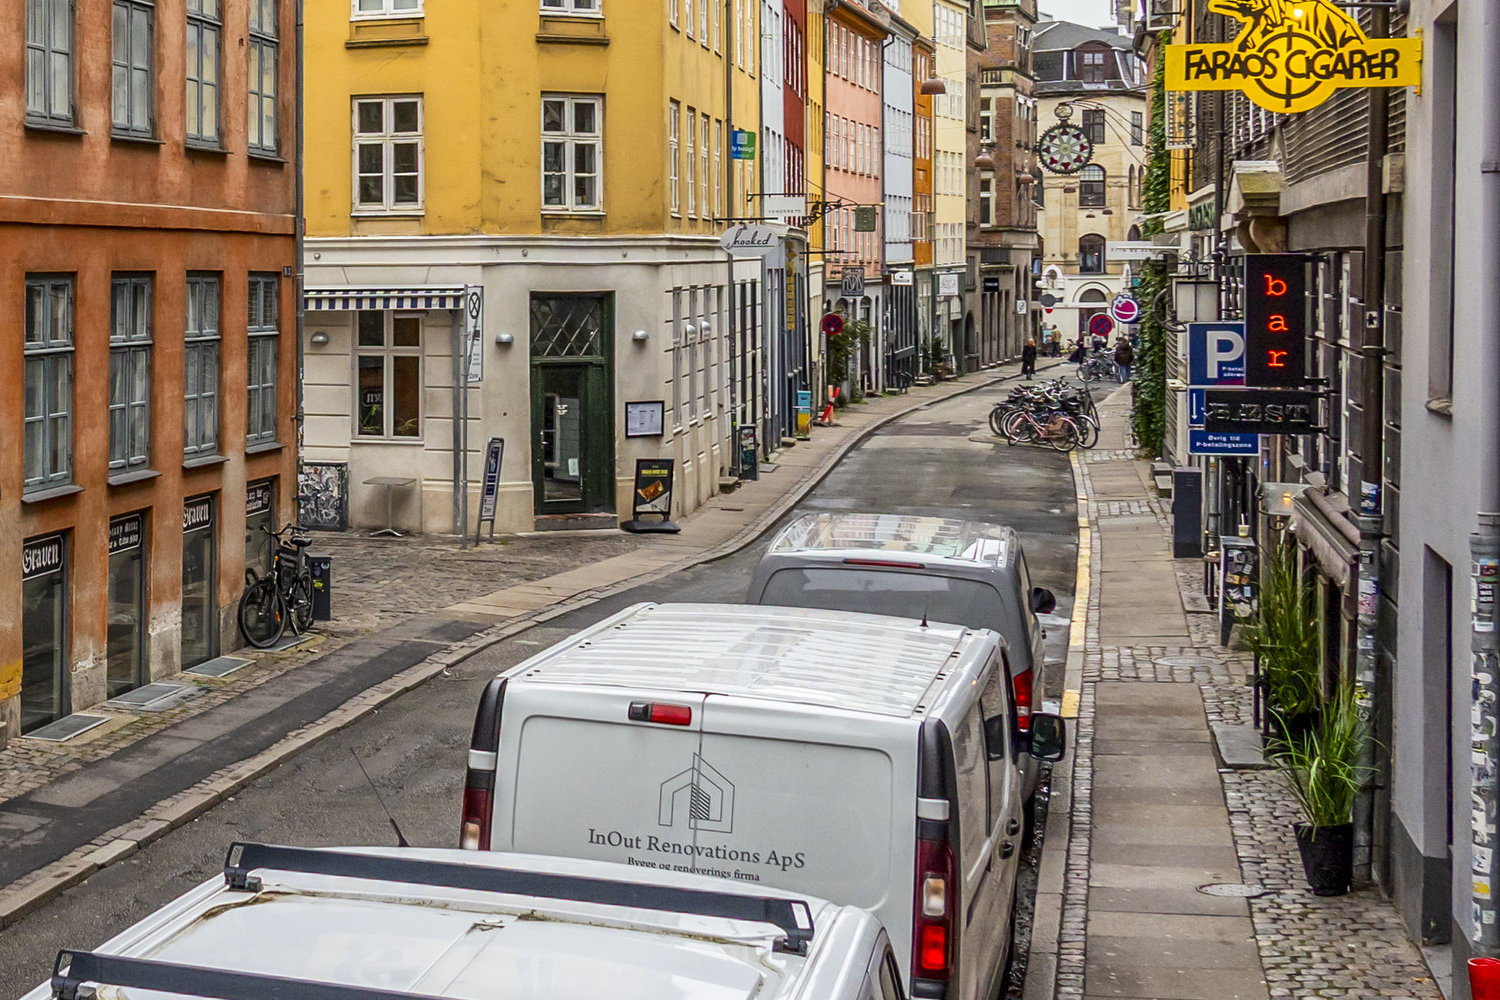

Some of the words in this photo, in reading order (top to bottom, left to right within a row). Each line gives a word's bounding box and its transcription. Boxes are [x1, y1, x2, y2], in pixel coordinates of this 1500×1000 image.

[1185, 49, 1279, 80] FARAOS
[1285, 49, 1399, 80] CIGARER
[1264, 274, 1289, 367] bar
[1206, 330, 1244, 378] P
[588, 828, 641, 850] InOut
[647, 835, 760, 864] Renovations
[765, 850, 805, 871] ApS
[673, 863, 731, 879] renoverings
[733, 869, 760, 882] firma
